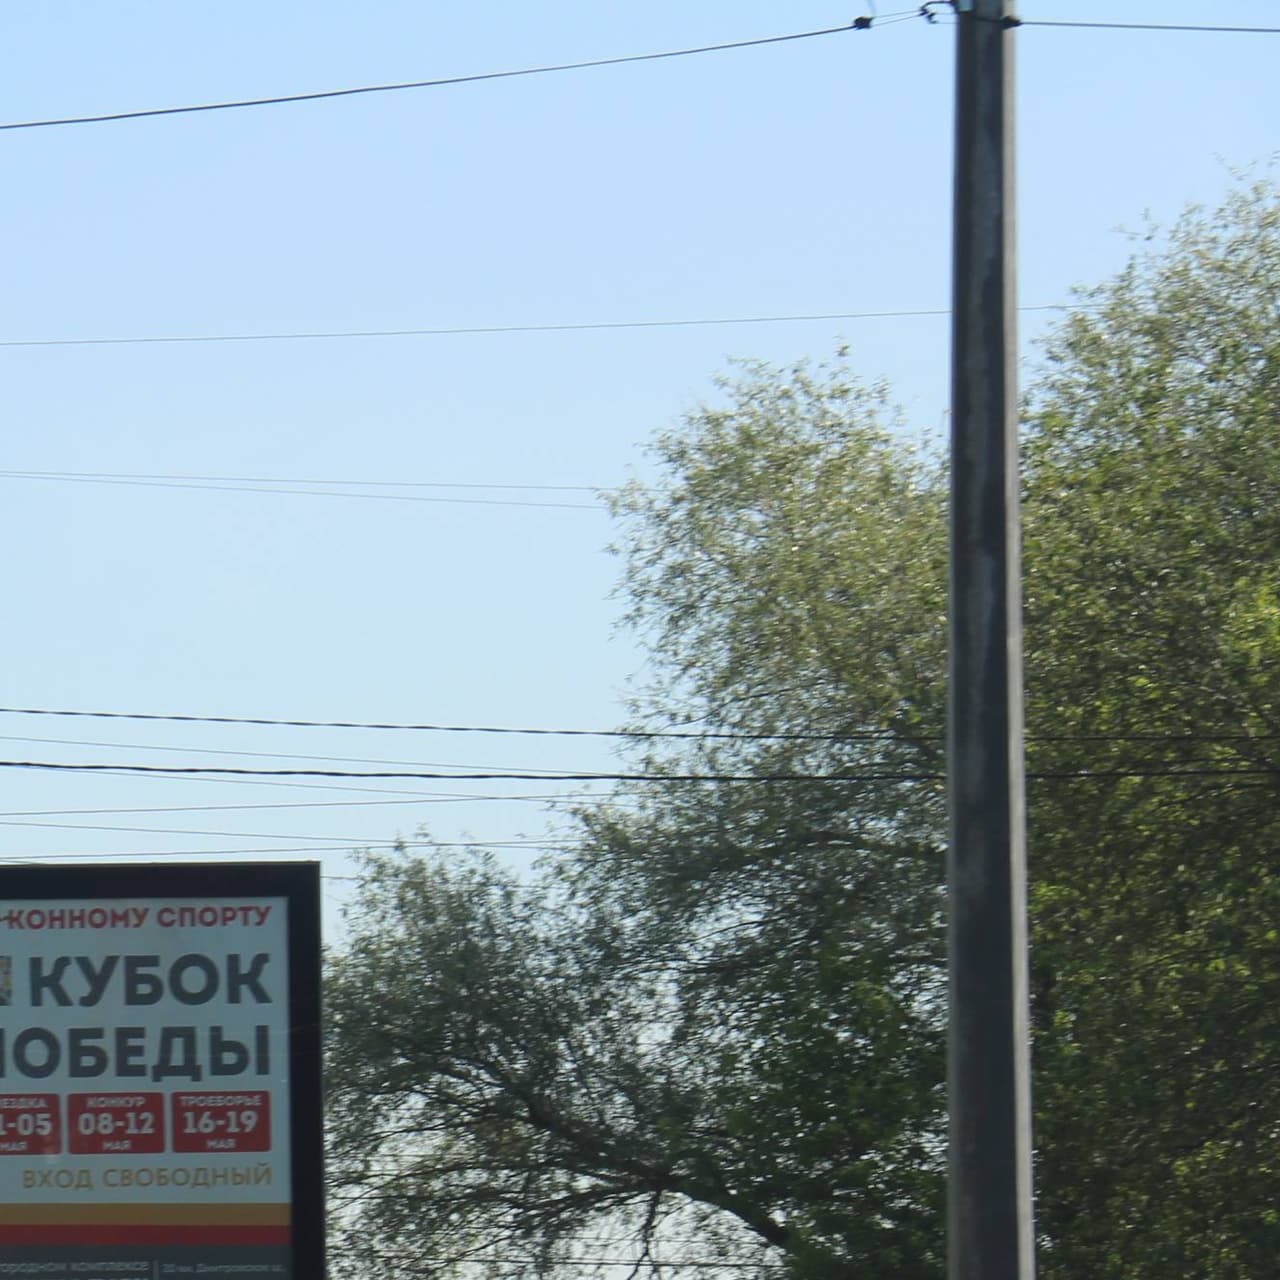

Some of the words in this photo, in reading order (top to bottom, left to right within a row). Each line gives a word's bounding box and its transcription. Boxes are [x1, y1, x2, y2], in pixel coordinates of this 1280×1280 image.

[6, 908, 149, 929] КОННОМУ
[157, 906, 272, 927] СПОРТУ
[29, 953, 273, 1007] КУБОК
[78, 1111, 155, 1135] 08-12
[183, 1110, 258, 1133] 16-19
[0, 1141, 28, 1152] МАЯ
[103, 1140, 131, 1151] МАЯ
[206, 1138, 236, 1150] МАЯ
[22, 1168, 94, 1189] ВХОД
[102, 1163, 273, 1188] СВОБОДНЫЙ
